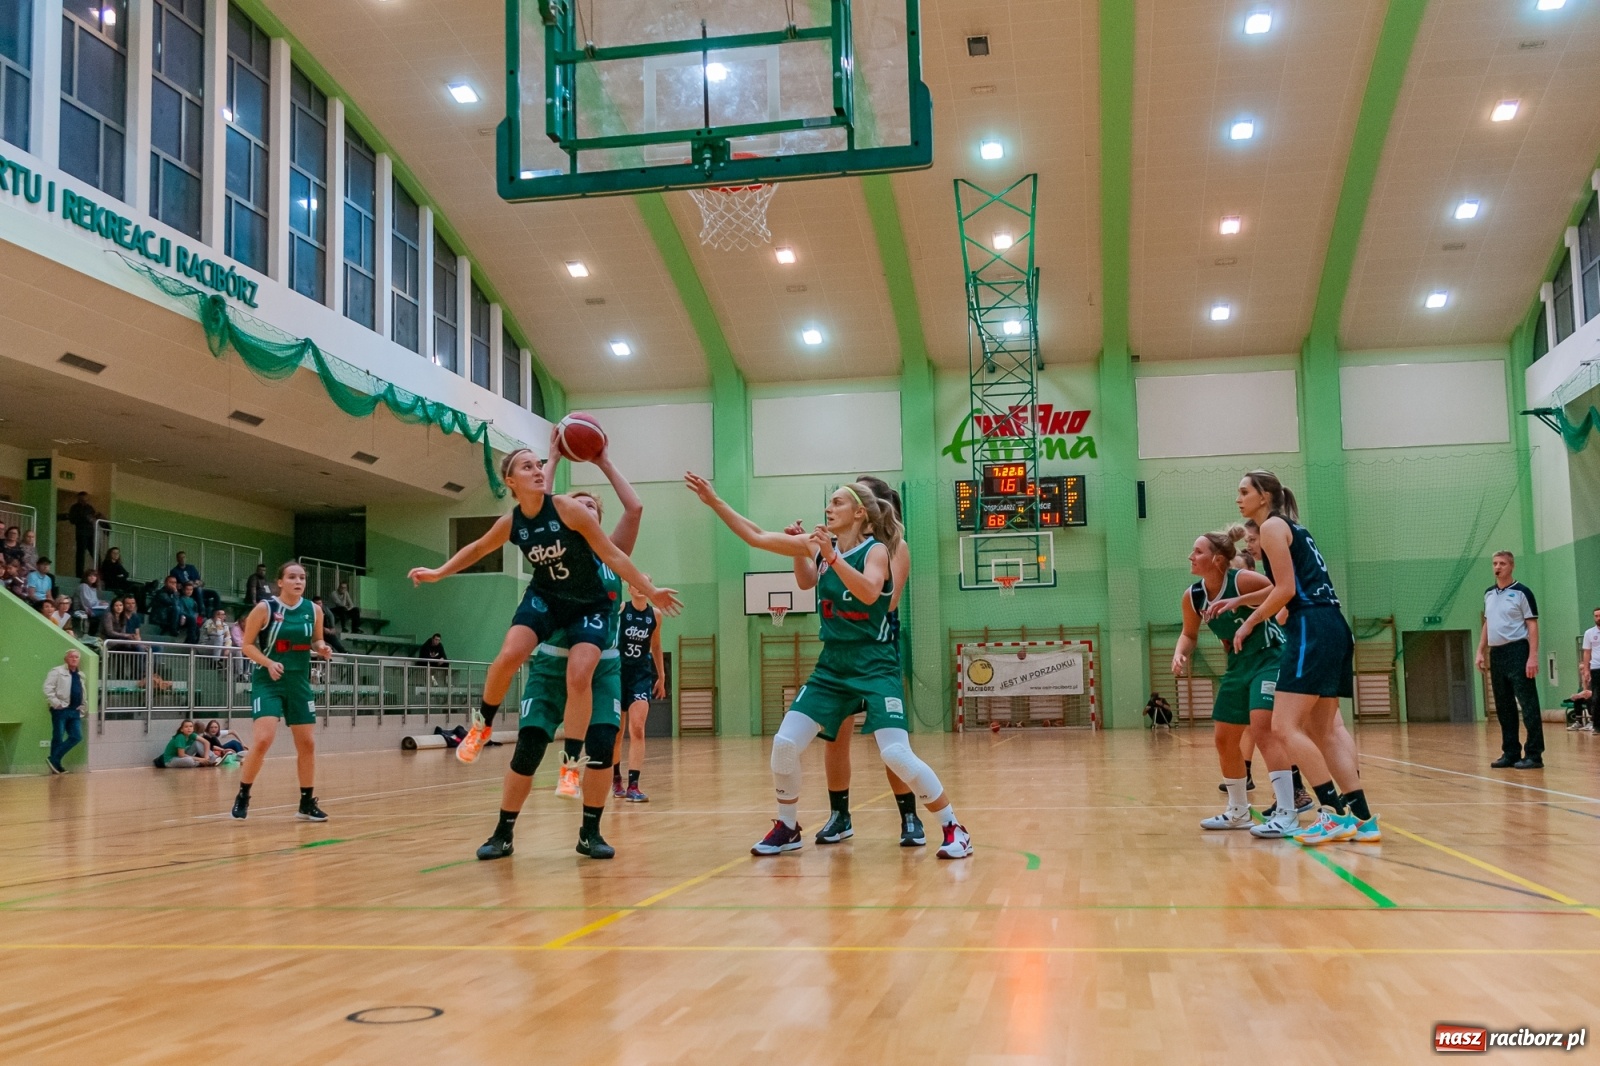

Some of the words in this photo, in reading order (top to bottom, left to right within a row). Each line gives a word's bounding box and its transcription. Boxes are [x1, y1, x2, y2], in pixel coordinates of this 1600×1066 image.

[47, 181, 56, 213] I
[62, 188, 172, 268] REKREACJI
[176, 245, 259, 309] RACIBÓRZ
[549, 561, 570, 580] 13
[624, 643, 643, 658] 35
[1000, 677, 1018, 690] JEST
[1020, 674, 1028, 682] W
